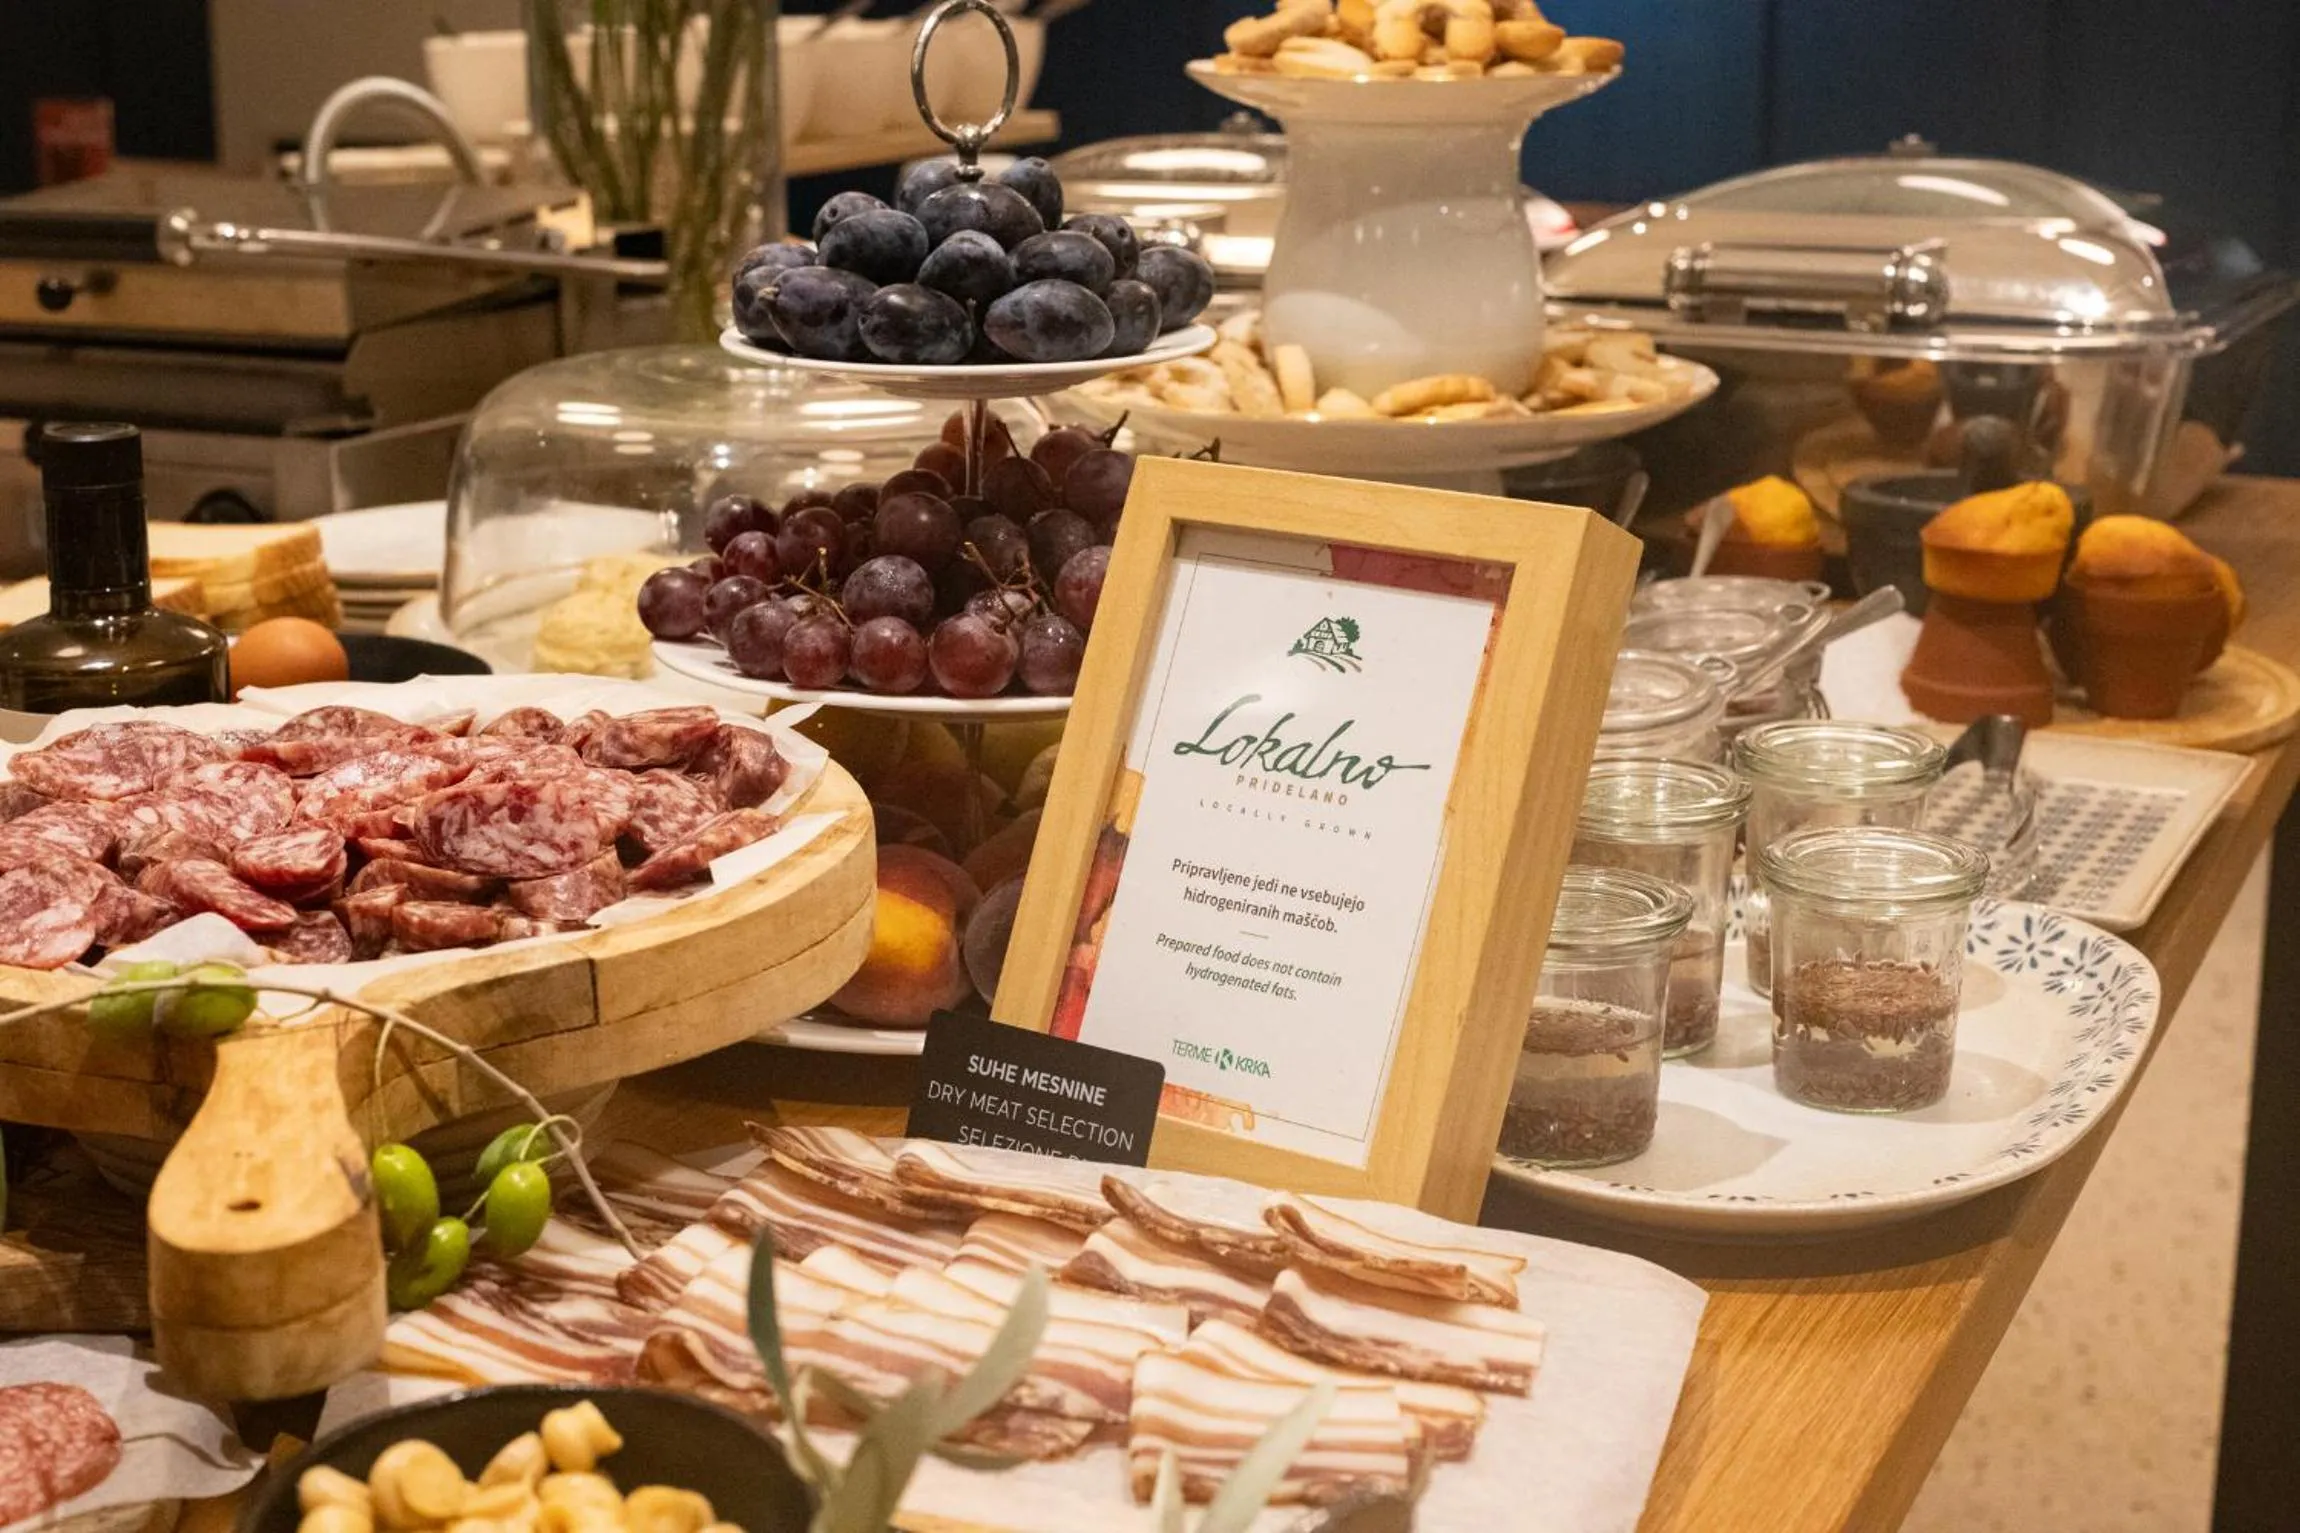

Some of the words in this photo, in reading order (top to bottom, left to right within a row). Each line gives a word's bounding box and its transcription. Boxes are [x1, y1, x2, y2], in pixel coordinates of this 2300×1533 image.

[1174, 694, 1431, 790] Lokalno
[1236, 774, 1348, 806] PRIDELANO
[1200, 799, 1286, 822] LOCALLY
[1304, 820, 1371, 840] GROWN
[1172, 858, 1250, 888] Pripravljene
[1251, 873, 1278, 893] jedi
[1280, 883, 1297, 898] ne
[1300, 886, 1365, 913] vsebujejo
[1183, 887, 1279, 921] hidrogeniranih
[1283, 910, 1338, 934] maščob.
[1155, 933, 1212, 957] Prepared
[1211, 945, 1241, 965] food
[1241, 950, 1269, 970] does
[1272, 960, 1293, 976] not
[1295, 965, 1342, 987] contain
[1185, 962, 1269, 994] hydrogenated
[1270, 980, 1298, 1001] fats.
[967, 1054, 1018, 1084] SUHE
[1021, 1067, 1108, 1106] MESNINE
[1172, 1039, 1212, 1063] TERME
[1235, 1056, 1271, 1078] KRKA
[927, 1080, 967, 1105] DRY
[970, 1091, 1023, 1120] MEAT
[1025, 1106, 1135, 1151] SELECTION
